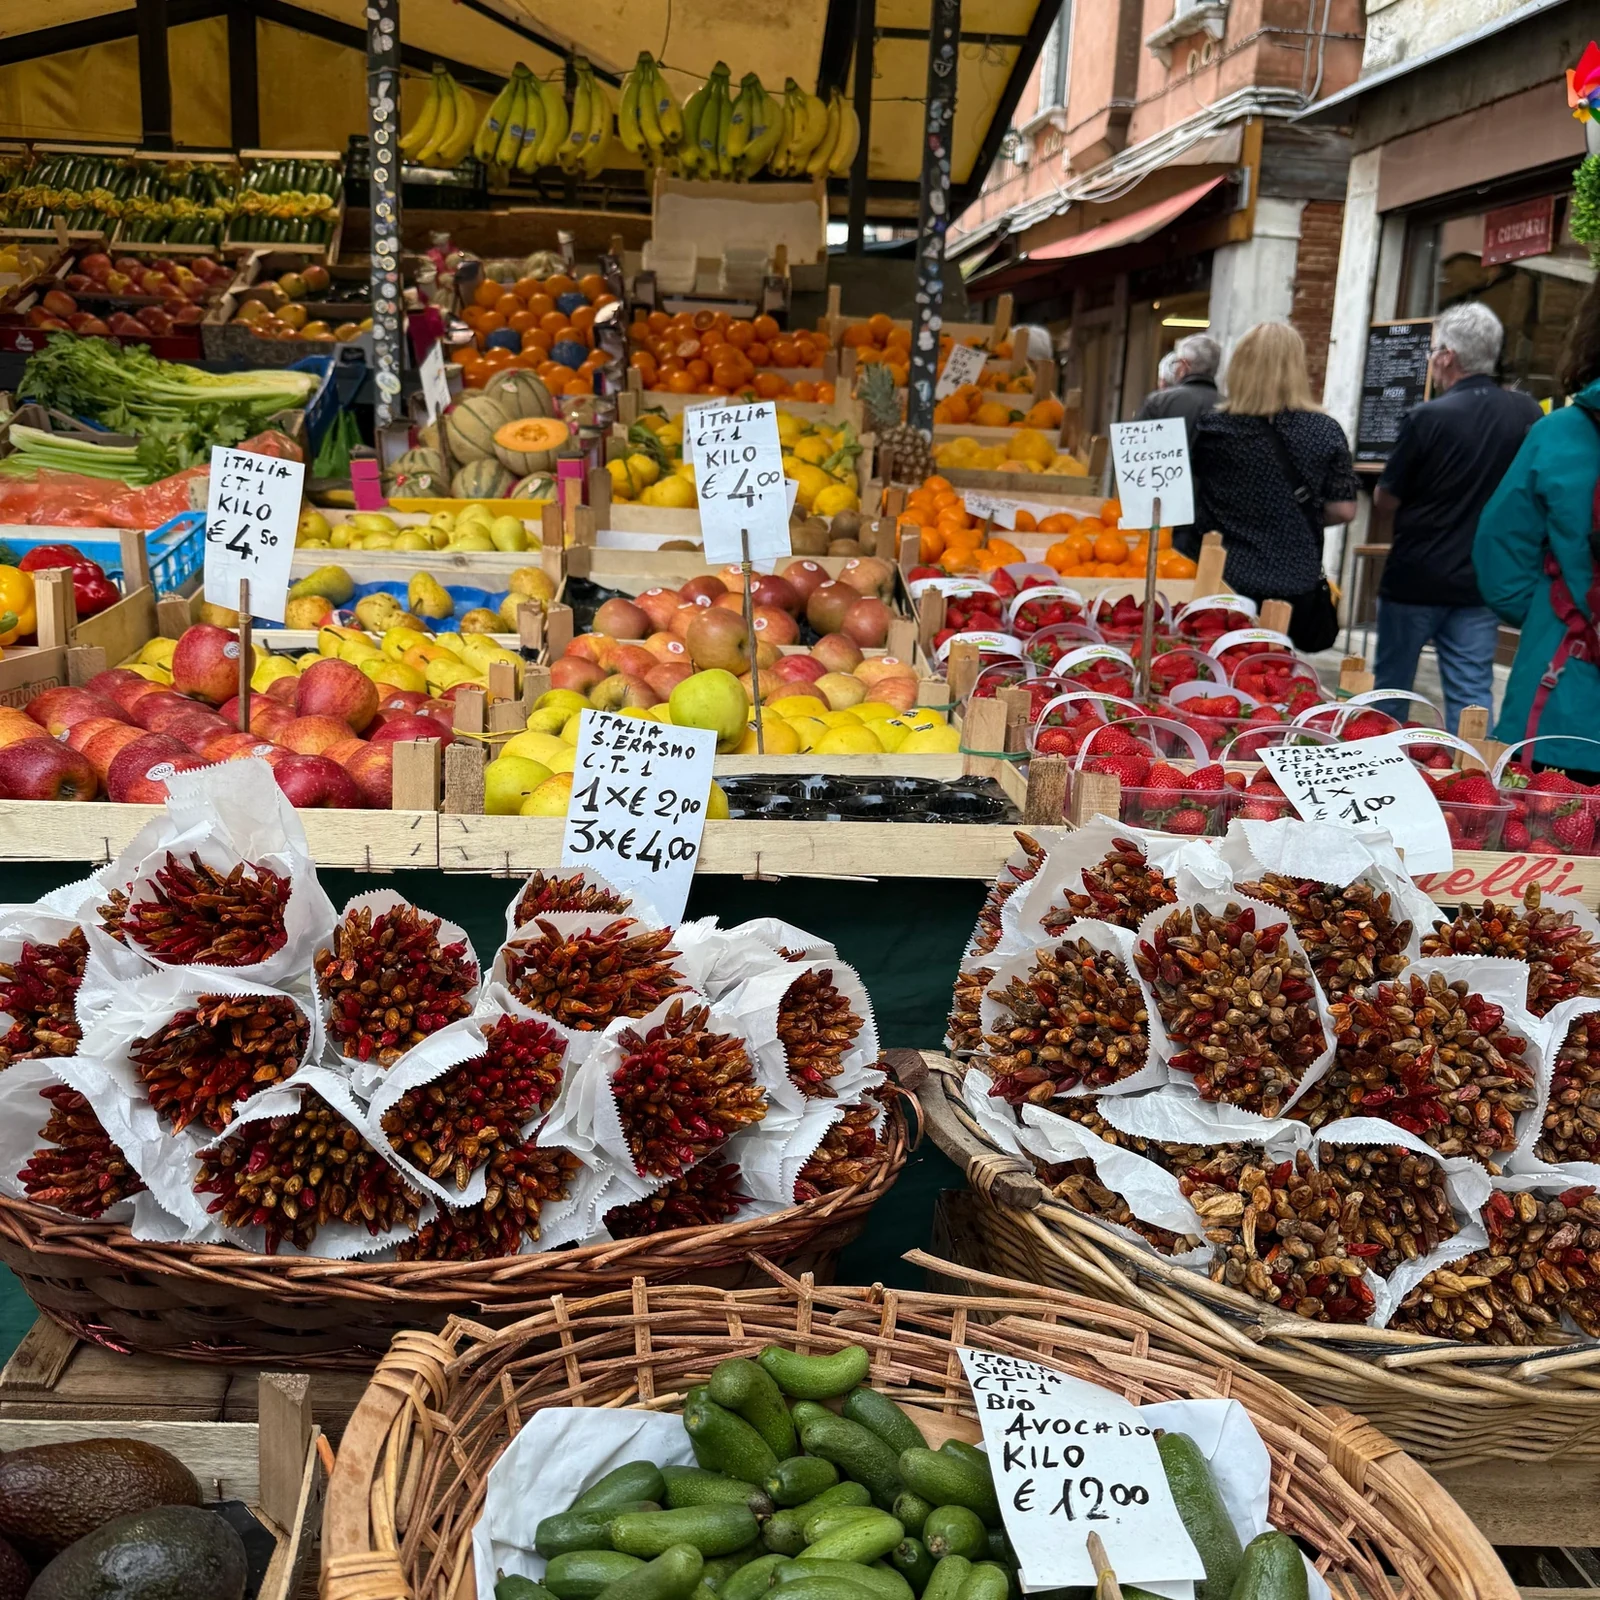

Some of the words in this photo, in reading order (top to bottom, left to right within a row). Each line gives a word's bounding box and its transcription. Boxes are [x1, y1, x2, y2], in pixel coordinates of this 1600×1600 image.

[706, 446, 757, 469] KILO
[218, 493, 272, 521] KILO
[1004, 1412, 1151, 1440] AVOCADO
[1003, 1441, 1085, 1473] KILO
